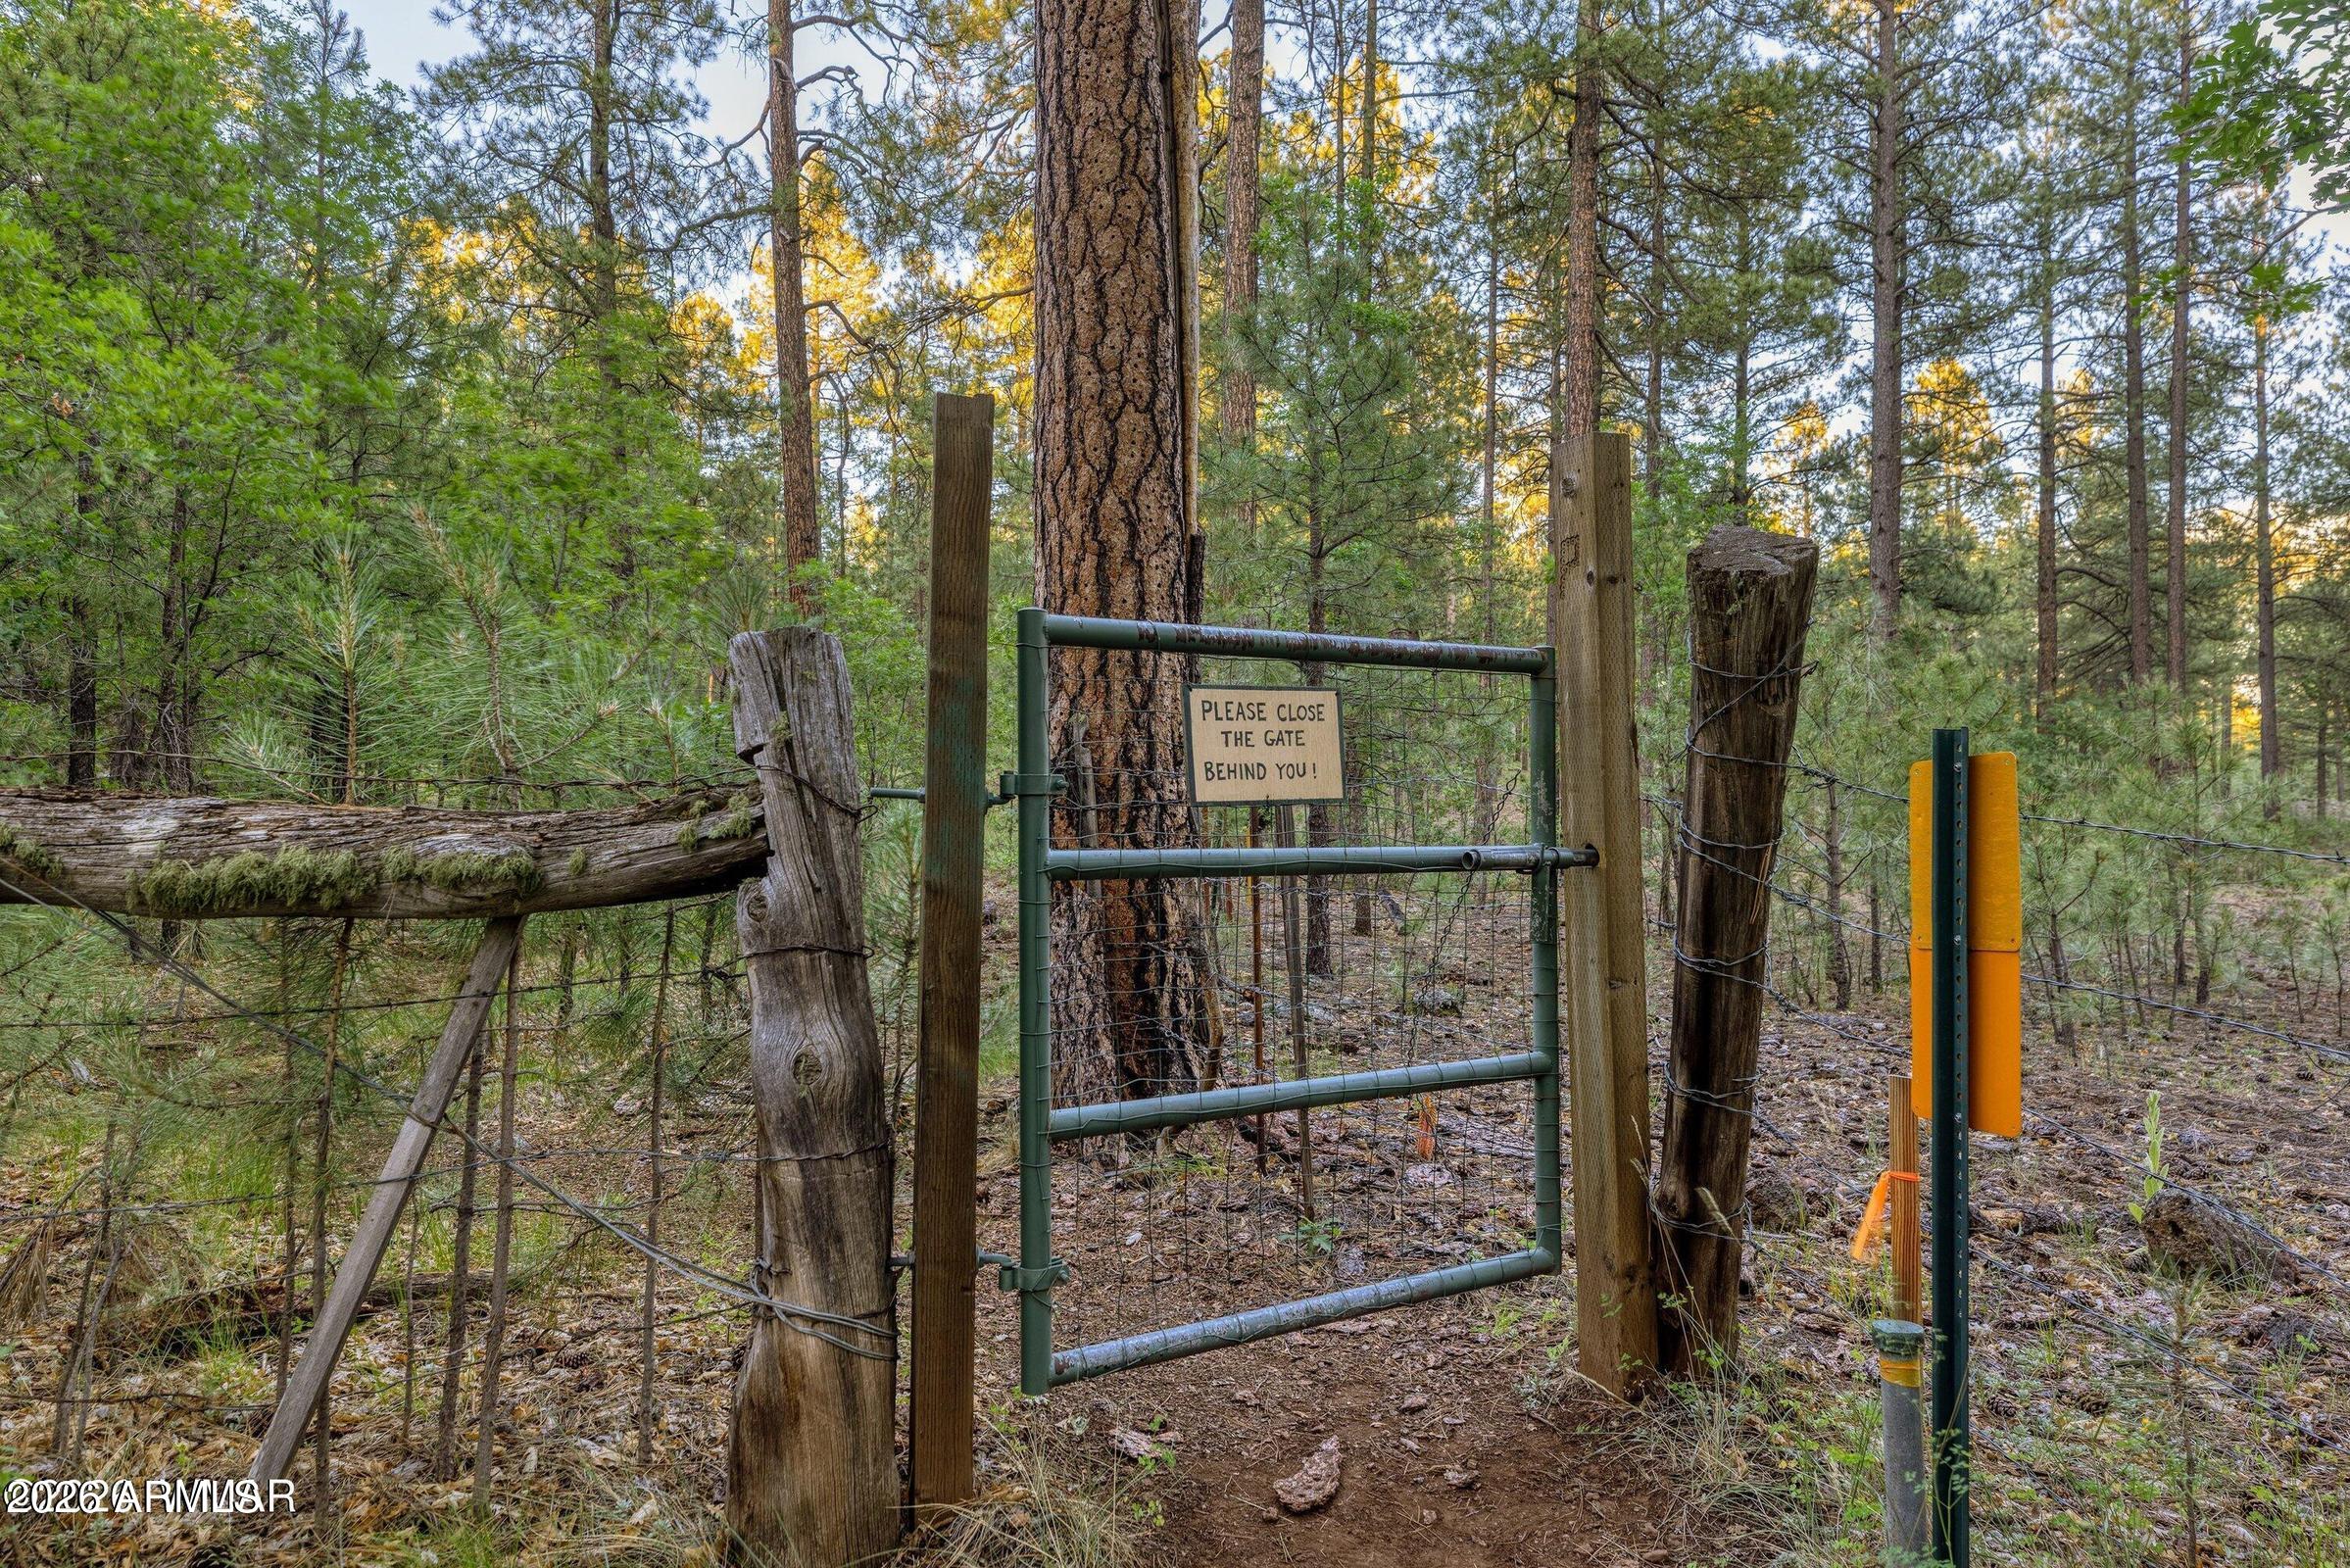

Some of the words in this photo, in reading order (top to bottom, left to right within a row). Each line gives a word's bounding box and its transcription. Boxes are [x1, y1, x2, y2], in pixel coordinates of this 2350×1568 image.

[1200, 700, 1267, 722] PLEASE
[1277, 703, 1325, 722] CLOSE
[1220, 730, 1255, 748] THE
[1264, 729, 1305, 747] GATE
[1203, 760, 1267, 781] BEHIND
